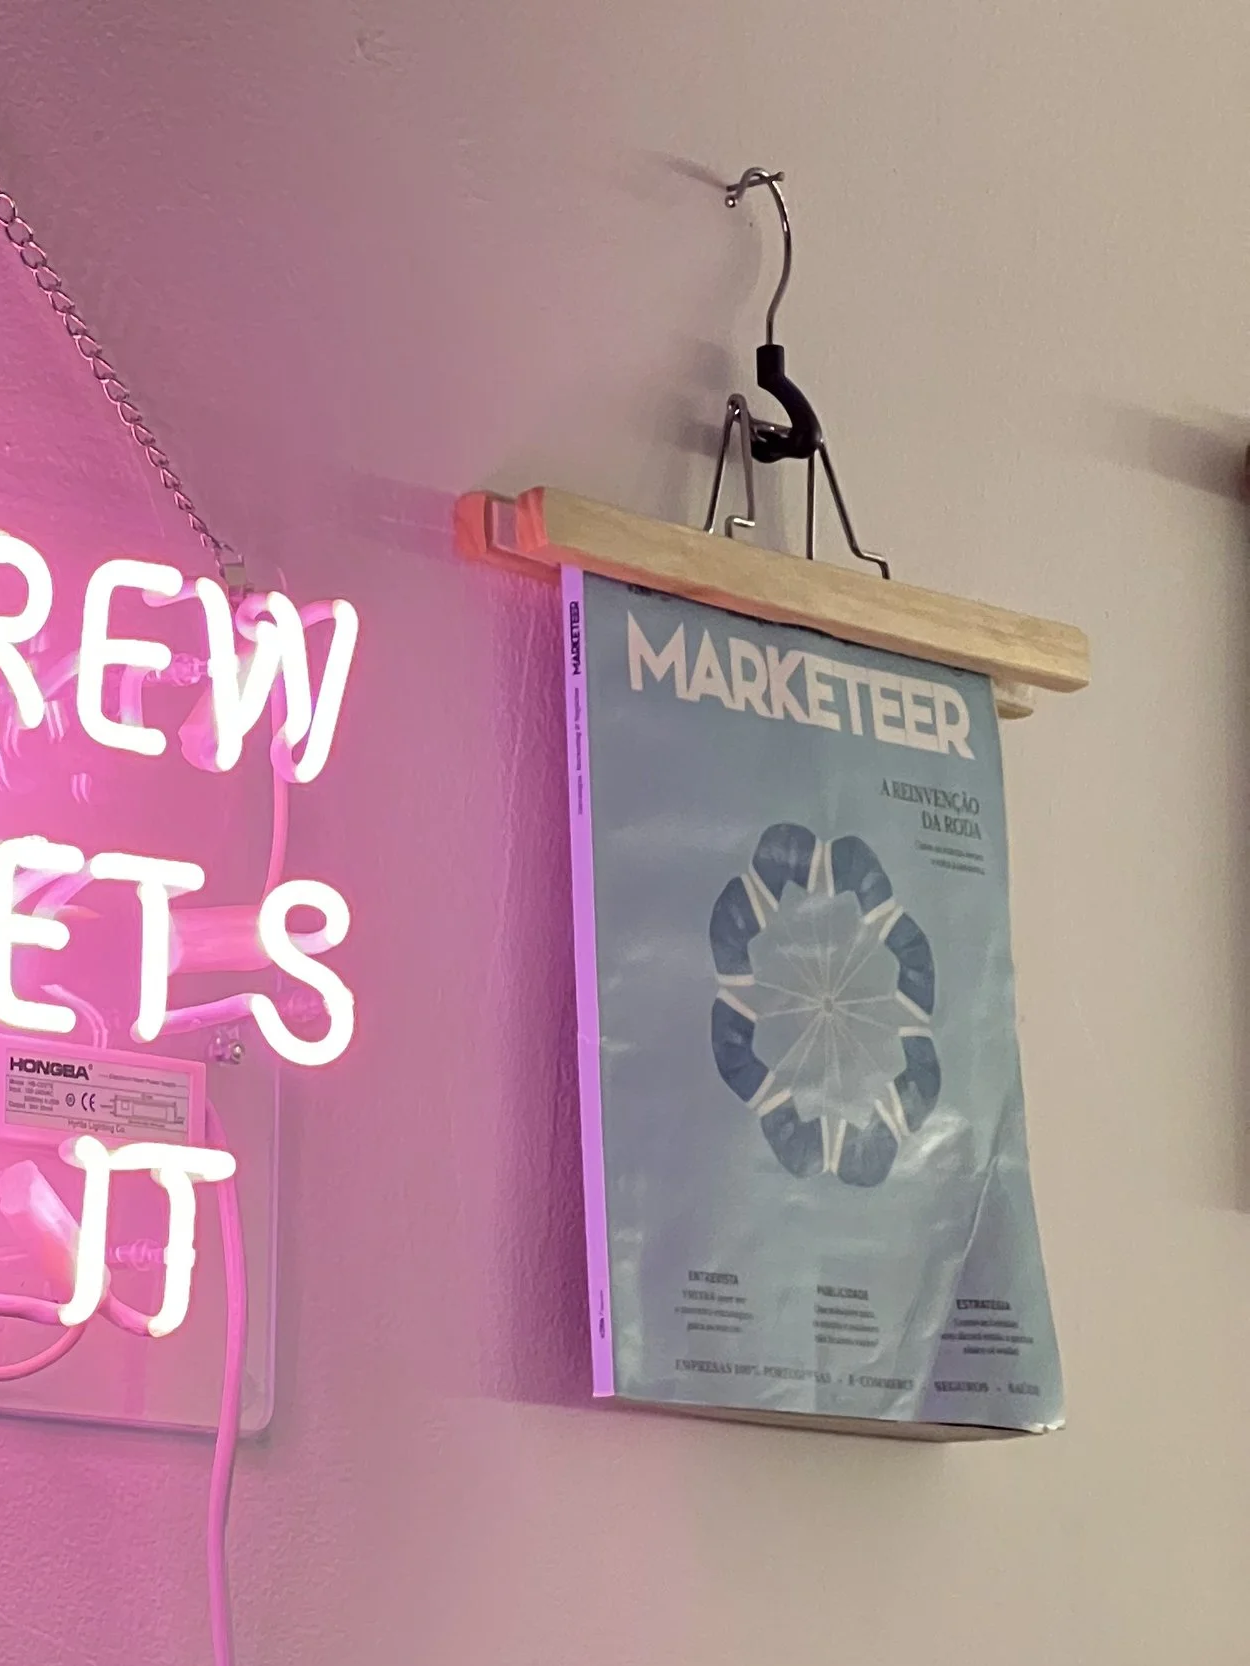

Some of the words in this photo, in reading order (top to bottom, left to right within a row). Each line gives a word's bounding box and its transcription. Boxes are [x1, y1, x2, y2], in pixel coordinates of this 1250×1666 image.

[626, 608, 976, 760] MARKETEER
[921, 810, 941, 832] DA
[944, 815, 983, 840] RODA
[10, 1057, 90, 1081] HONGBA
[58, 1134, 236, 1338] IT
